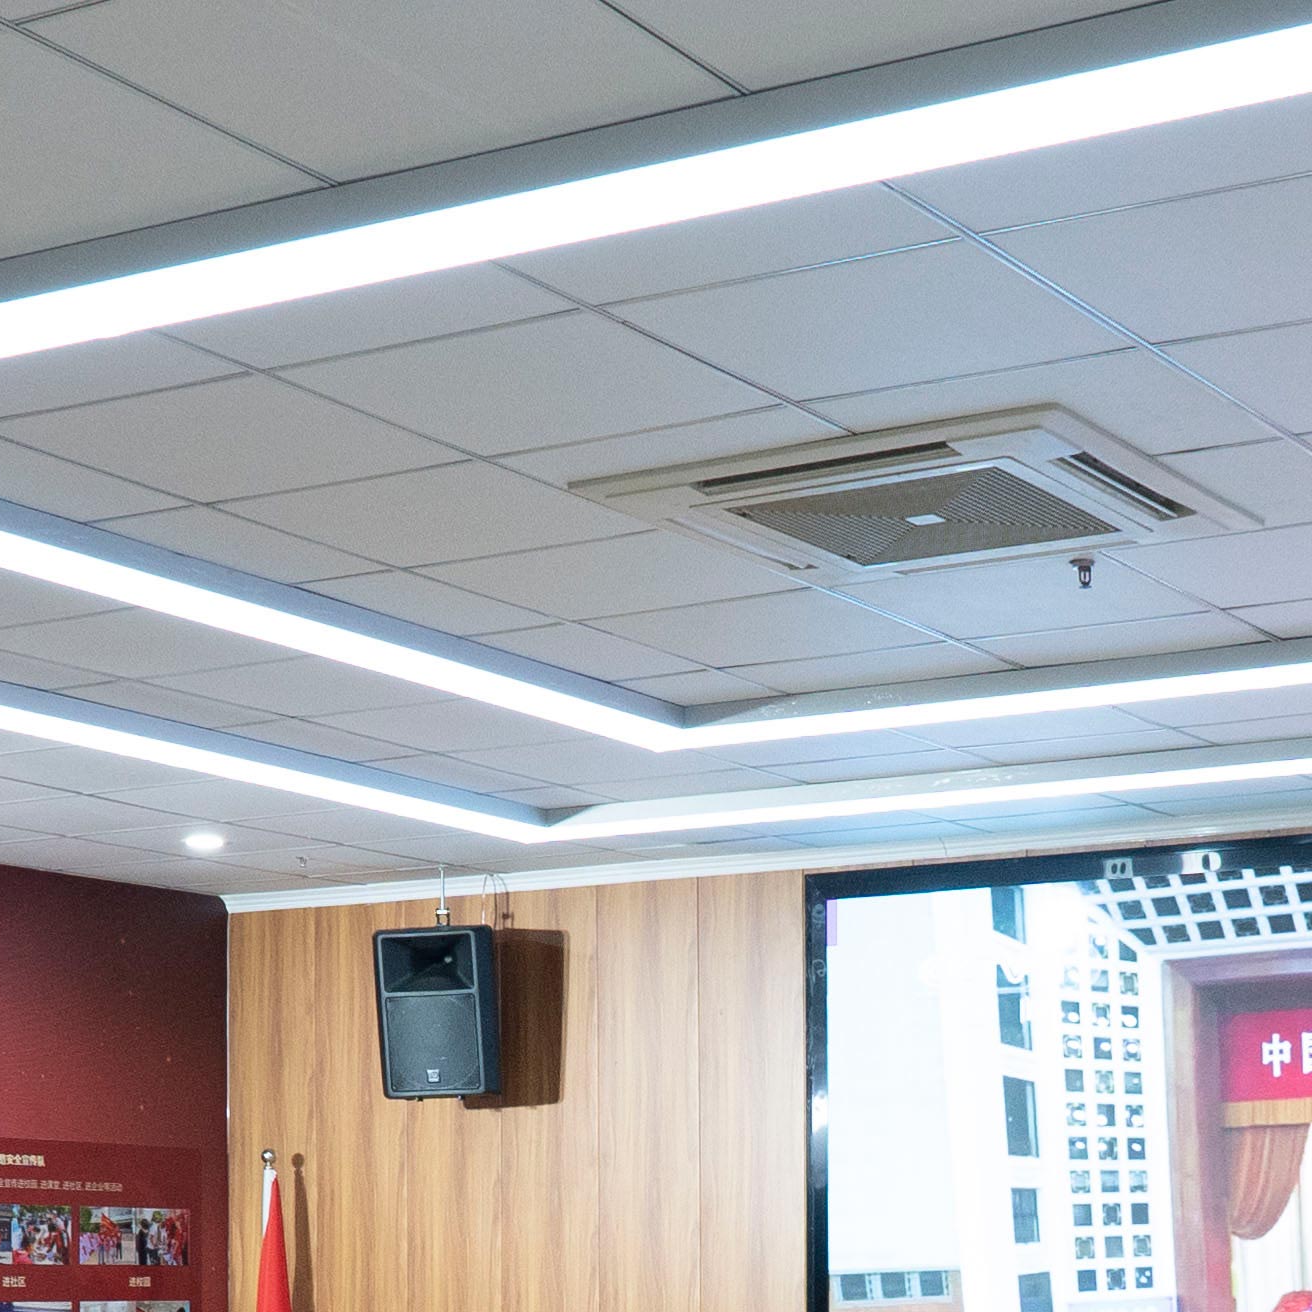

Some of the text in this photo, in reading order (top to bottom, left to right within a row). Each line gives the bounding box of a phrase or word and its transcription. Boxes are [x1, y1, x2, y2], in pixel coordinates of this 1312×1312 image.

[2, 1276, 26, 1288] 进社区
[128, 1276, 151, 1287] 进校园
